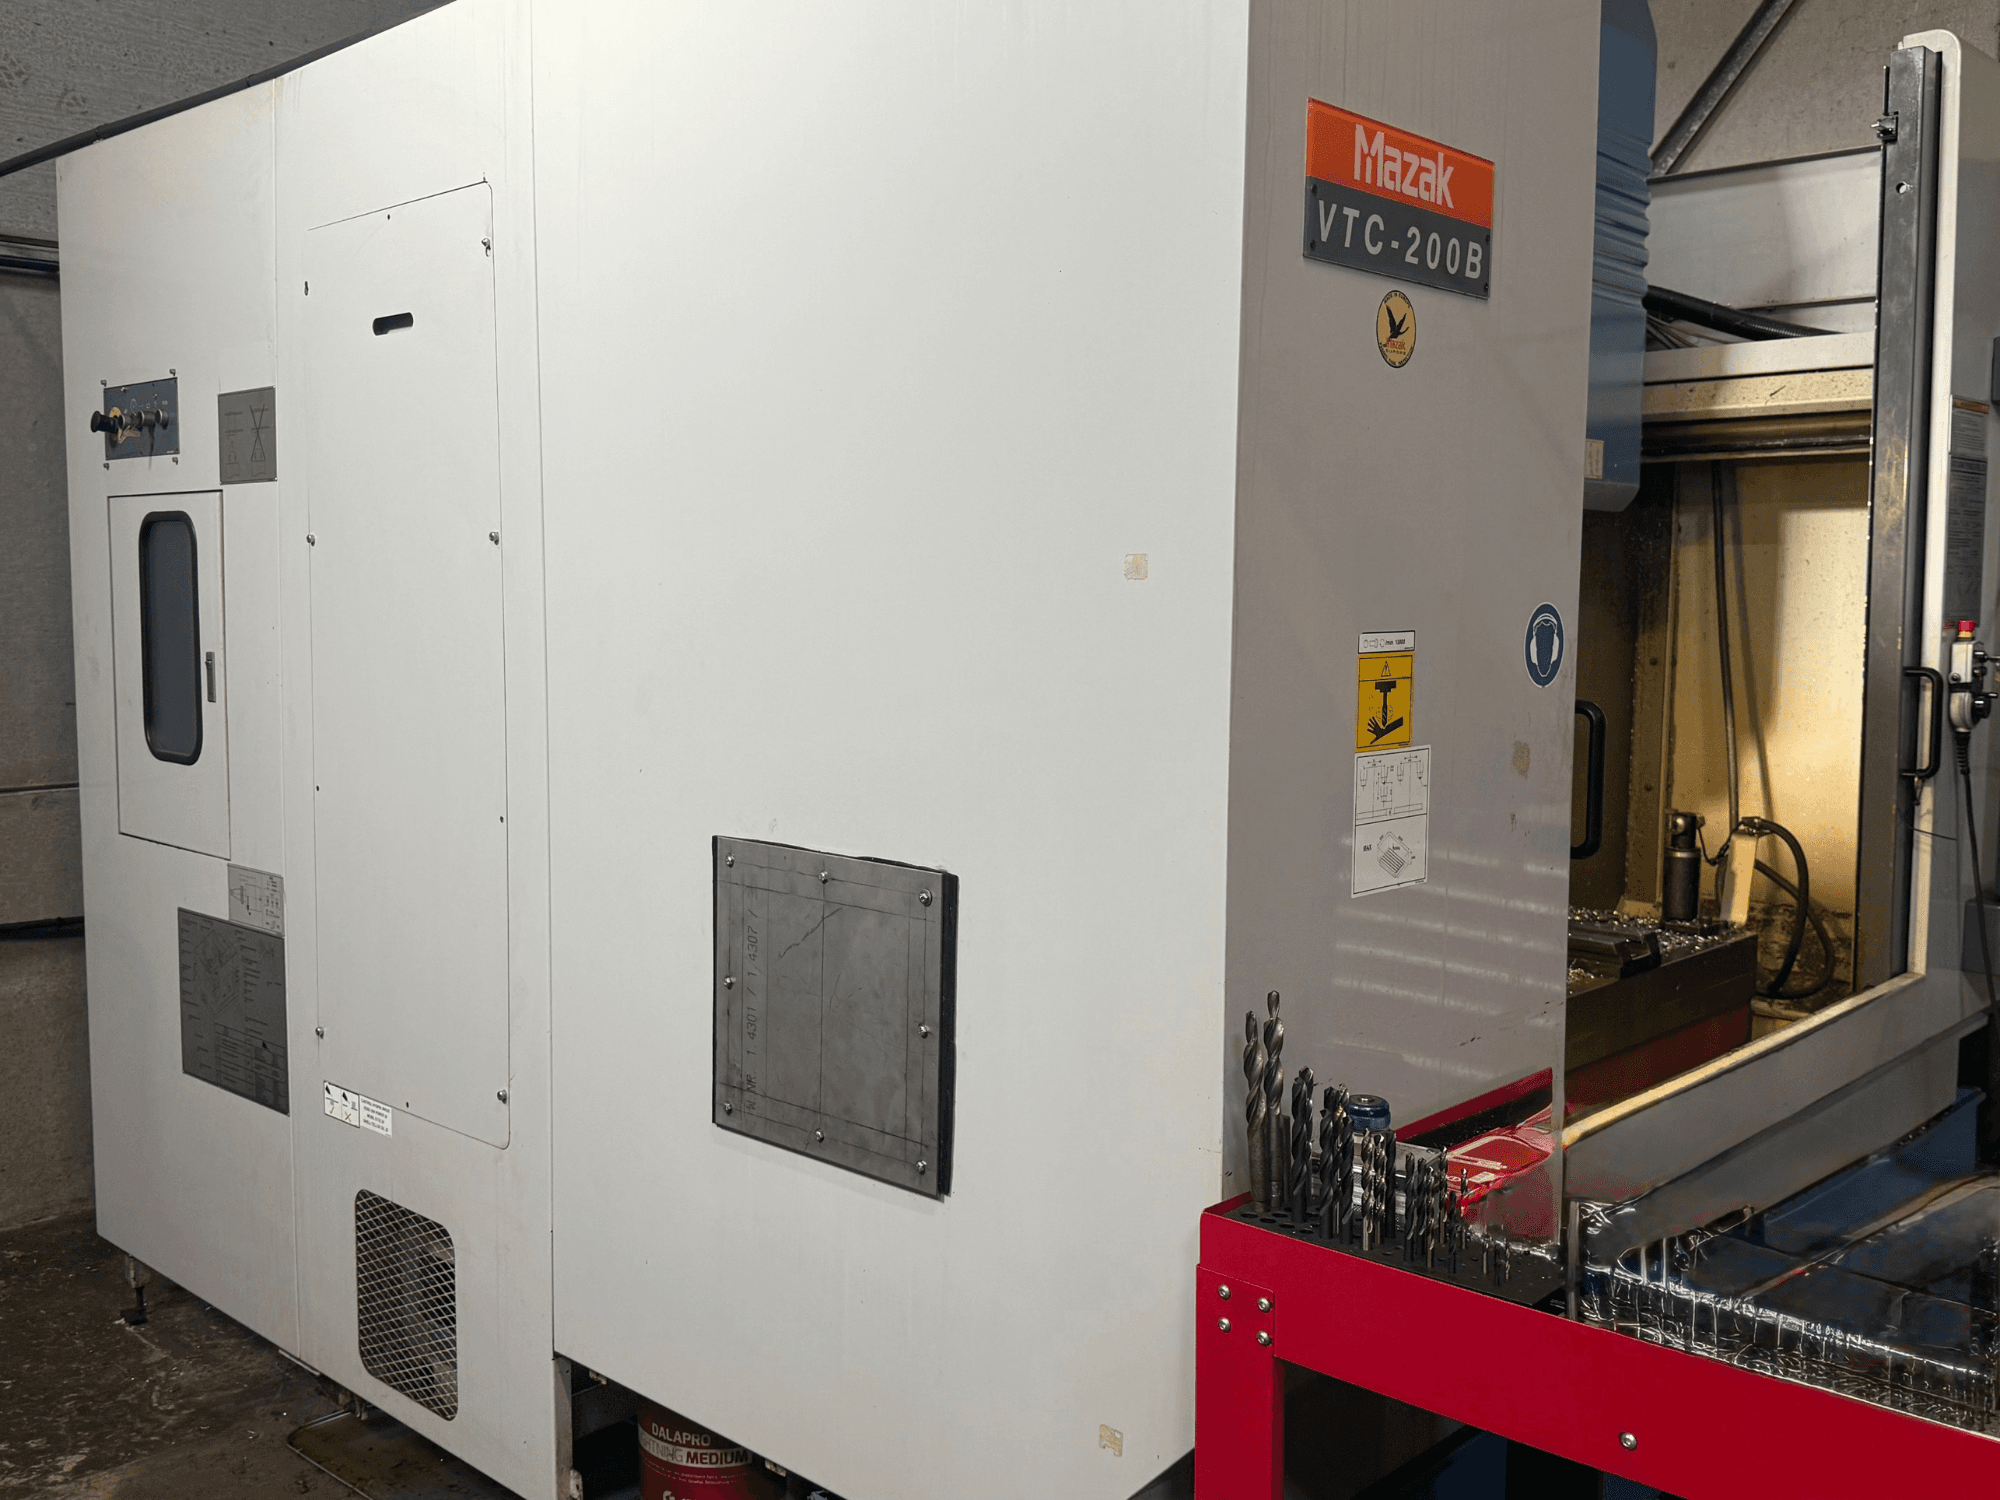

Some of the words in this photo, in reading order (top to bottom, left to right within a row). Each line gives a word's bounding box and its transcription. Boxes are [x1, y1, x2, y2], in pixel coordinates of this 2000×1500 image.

[1354, 123, 1454, 209] Mazak
[1318, 200, 1482, 279] VTC-200B
[651, 1422, 711, 1447] DALAPRO
[685, 1449, 749, 1466] MEDIUM
